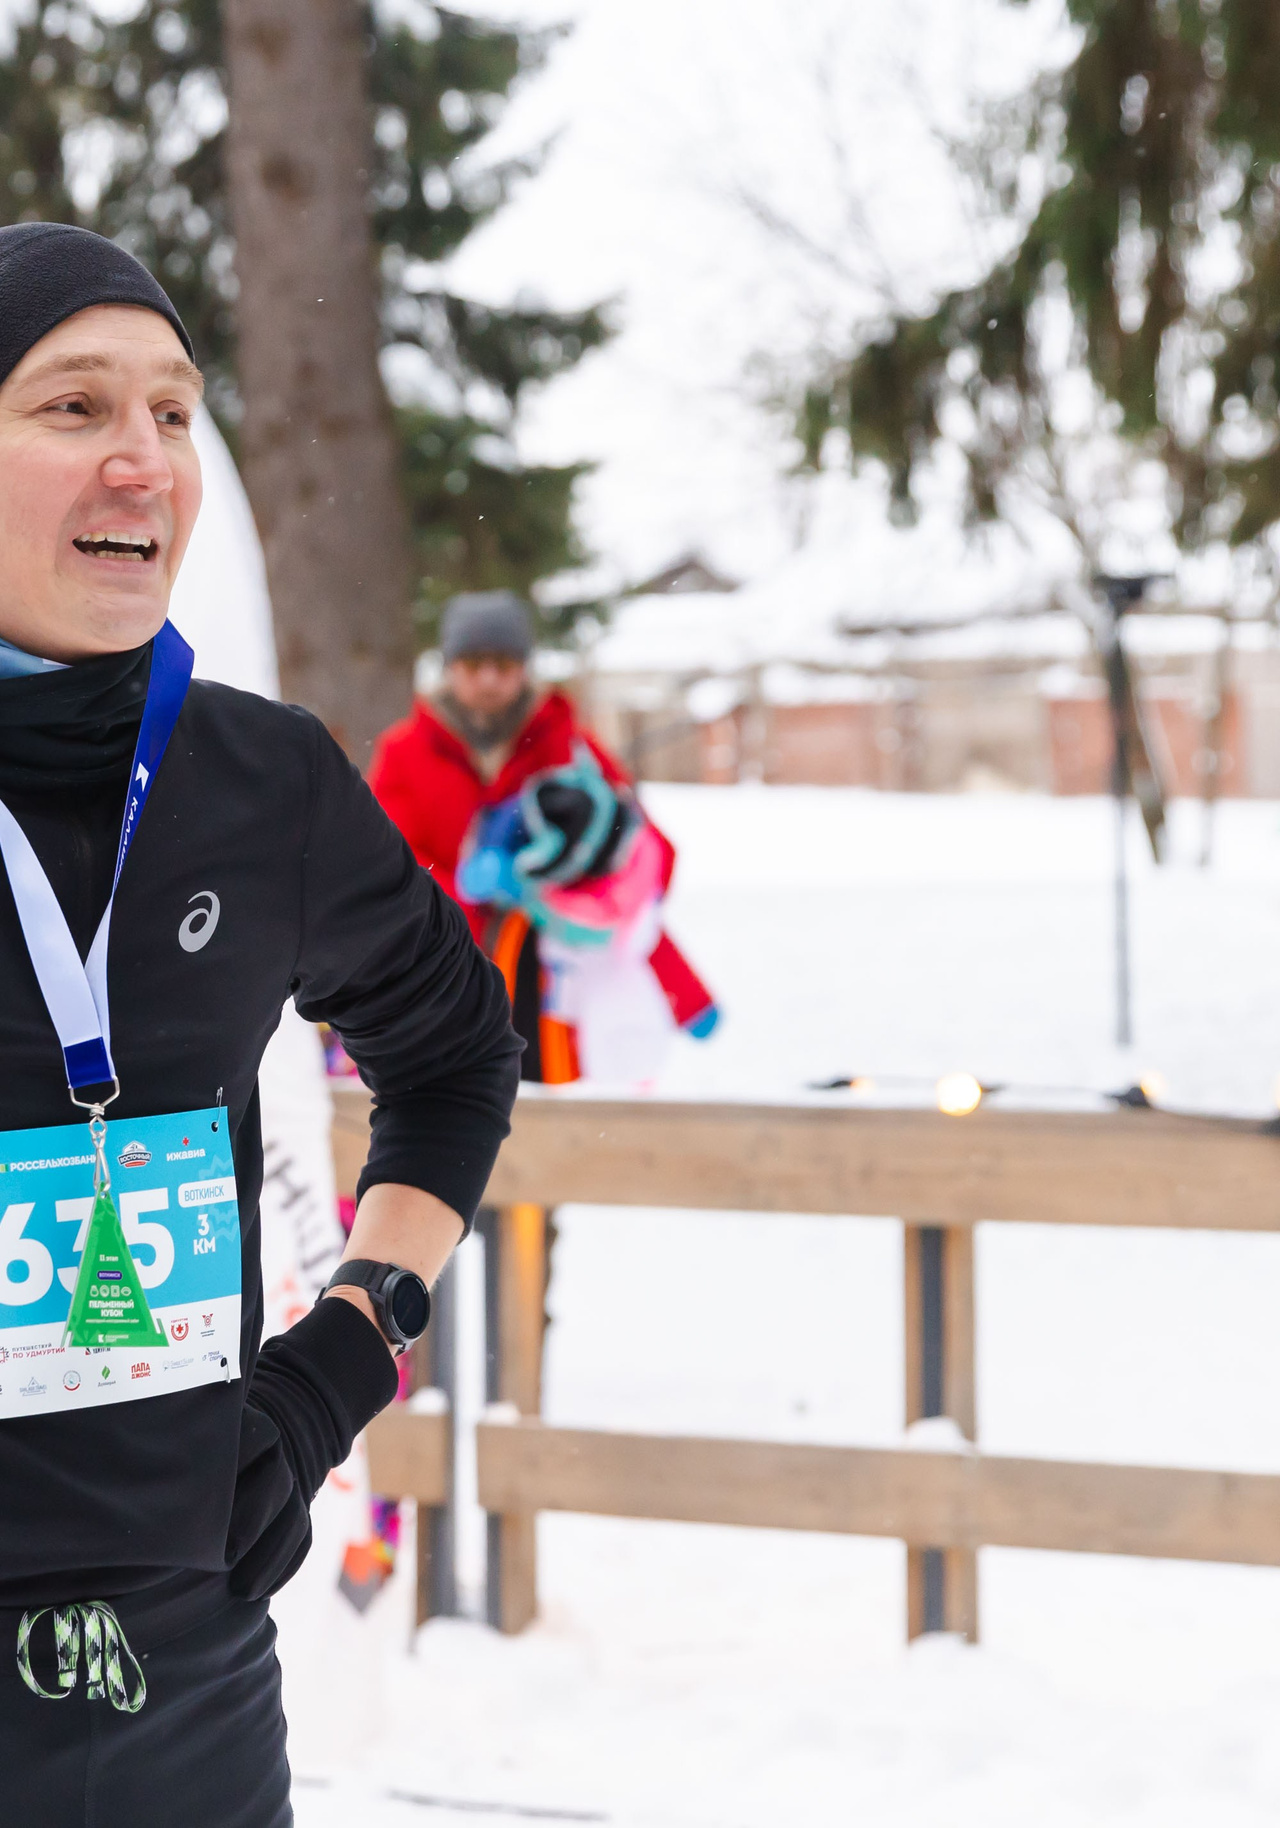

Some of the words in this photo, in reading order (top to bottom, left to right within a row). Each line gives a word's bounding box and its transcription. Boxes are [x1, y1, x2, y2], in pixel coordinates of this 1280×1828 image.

[184, 1186, 224, 1201] ВОТКИНСК
[197, 1213, 210, 1236] 3
[193, 1237, 216, 1255] КМ
[89, 1299, 134, 1308] ПЕЛЬМЕННЫЙ
[100, 1309, 124, 1317] КУБОК
[26, 1347, 66, 1359] УДМУРТИИ
[131, 1362, 151, 1373] ПАПА
